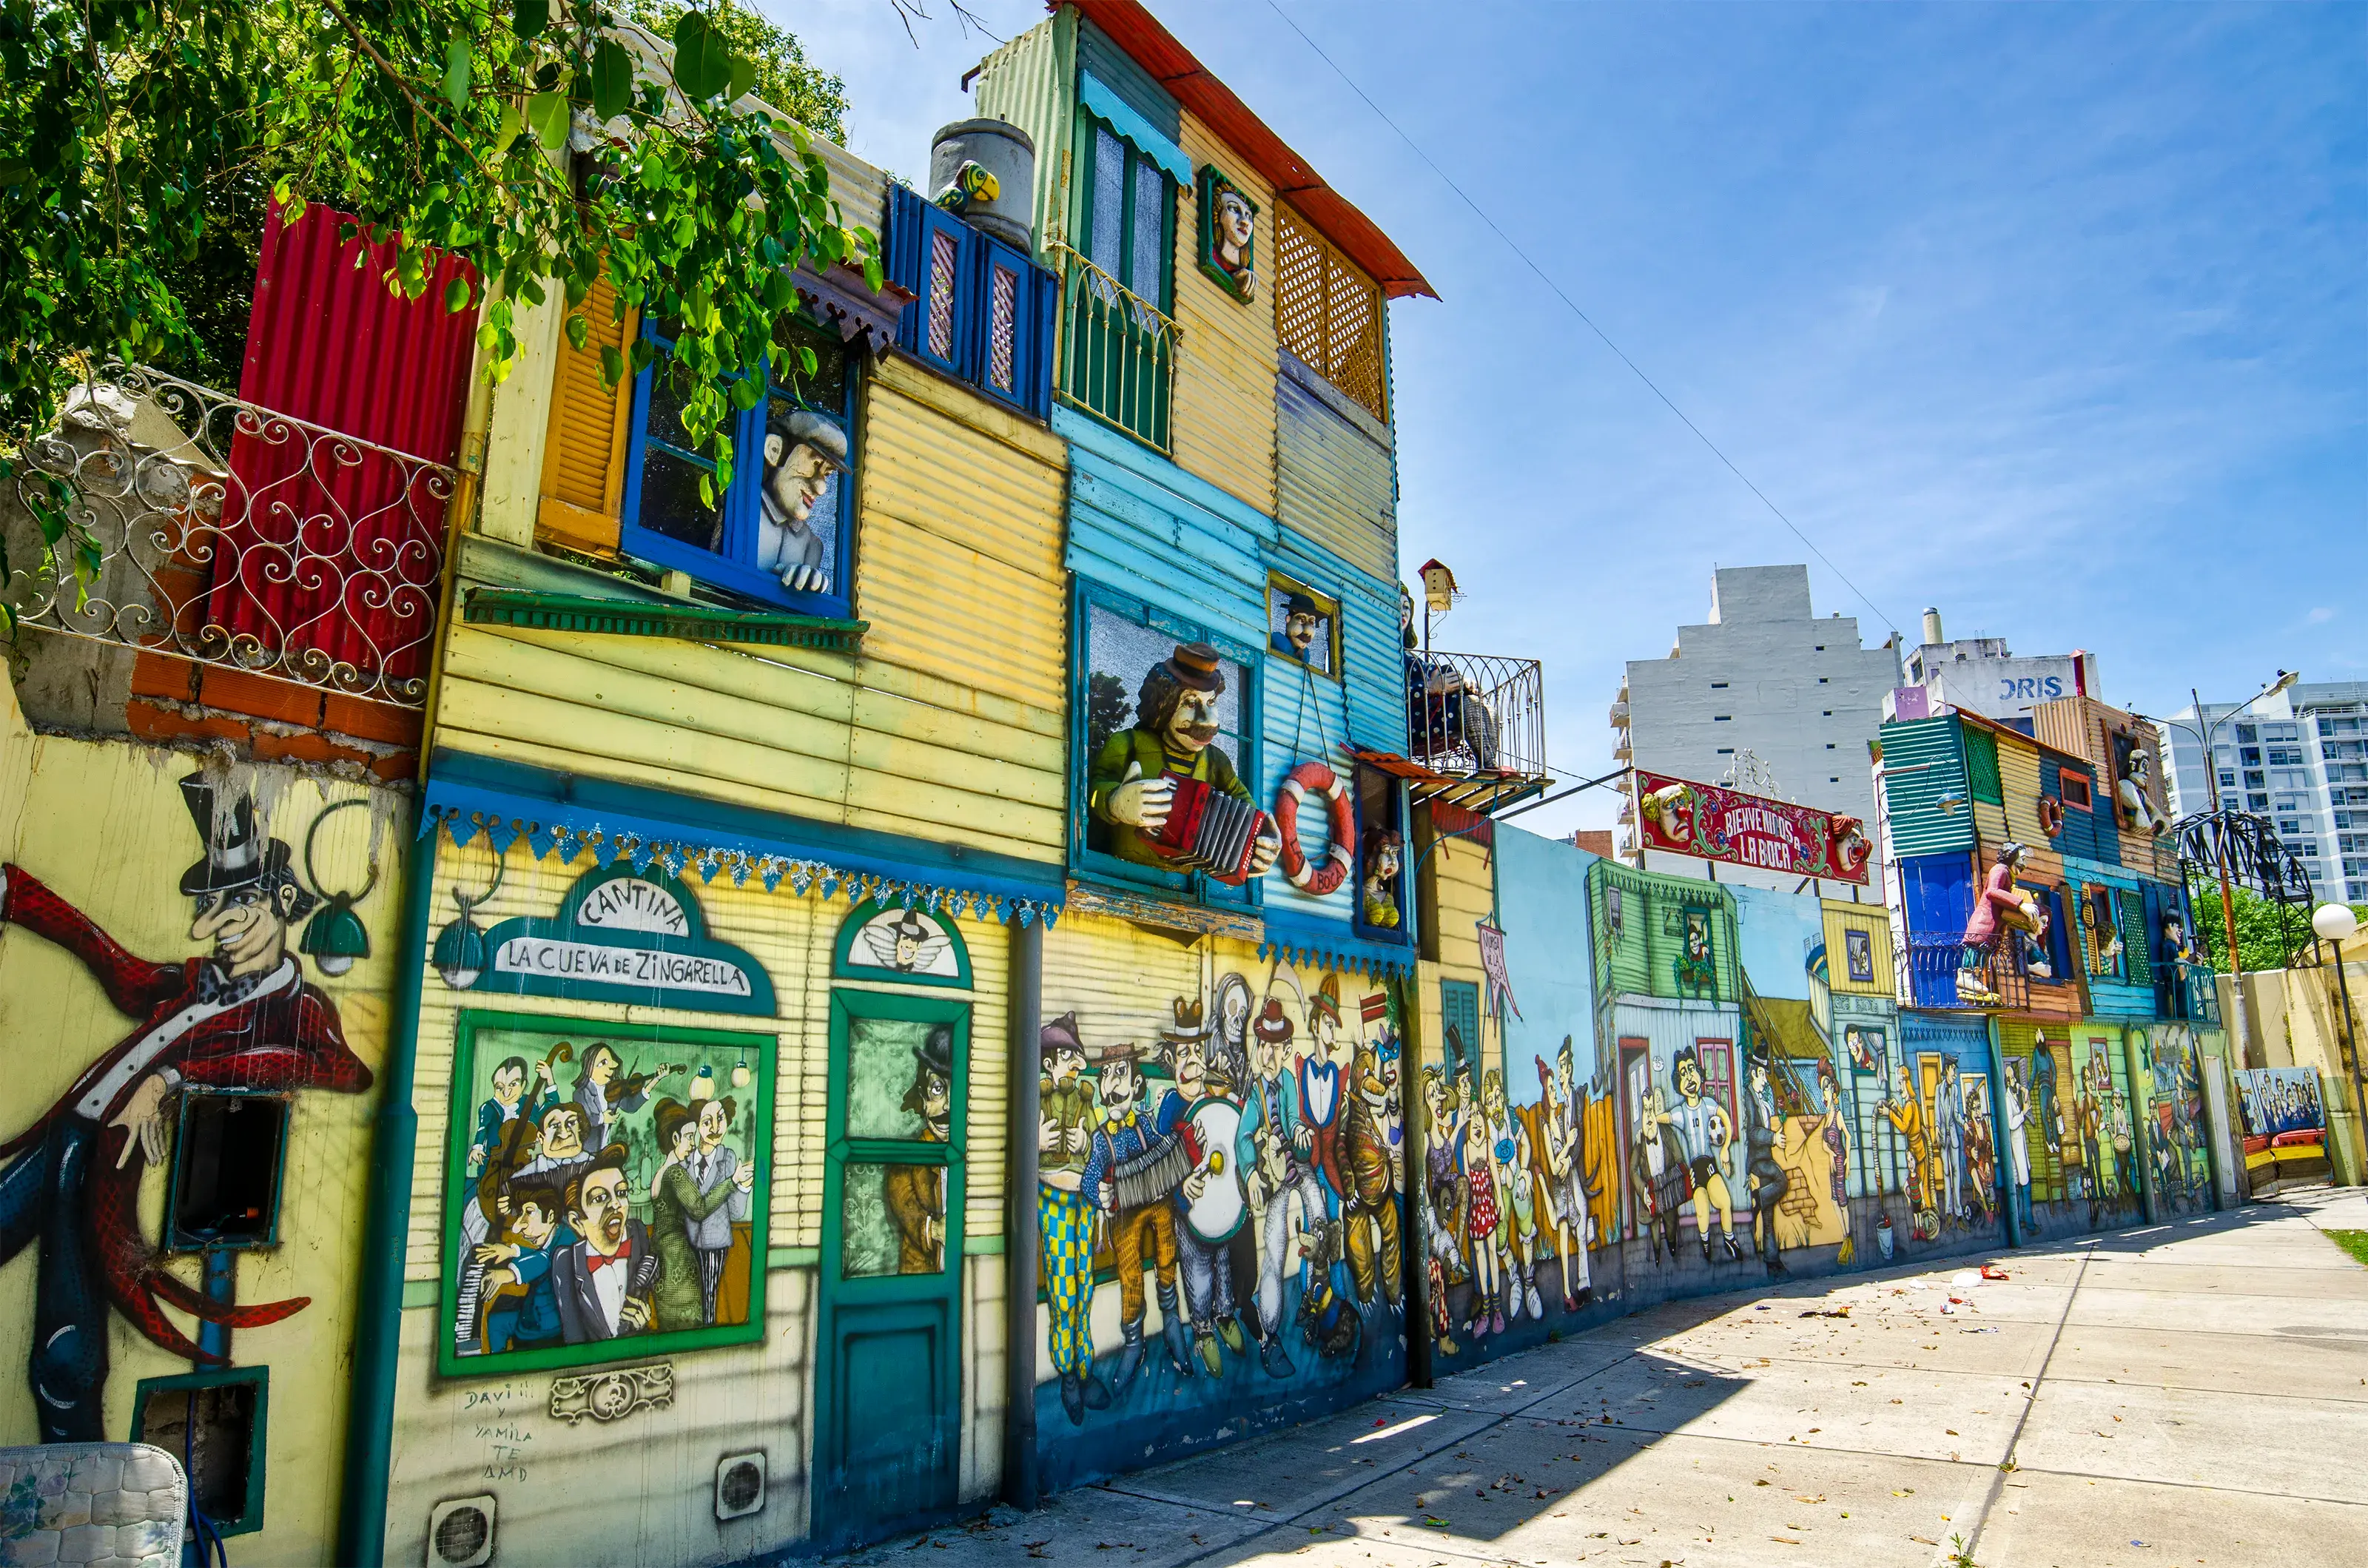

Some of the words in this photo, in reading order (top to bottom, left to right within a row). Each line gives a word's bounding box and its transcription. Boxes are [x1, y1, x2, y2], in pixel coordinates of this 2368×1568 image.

[1724, 807, 1793, 844] BIENVENIDOS
[1740, 835, 1758, 864] LA
[1758, 838, 1791, 869] BOCA
[1317, 867, 1345, 889] BOCA
[584, 879, 684, 932] CANTINA
[508, 941, 531, 967] LA
[537, 946, 609, 974] CUEVA
[615, 958, 630, 974] DE
[1692, 1118, 1700, 1128] 10
[1707, 1163, 1715, 1177] 10
[491, 1445, 521, 1461] TE
